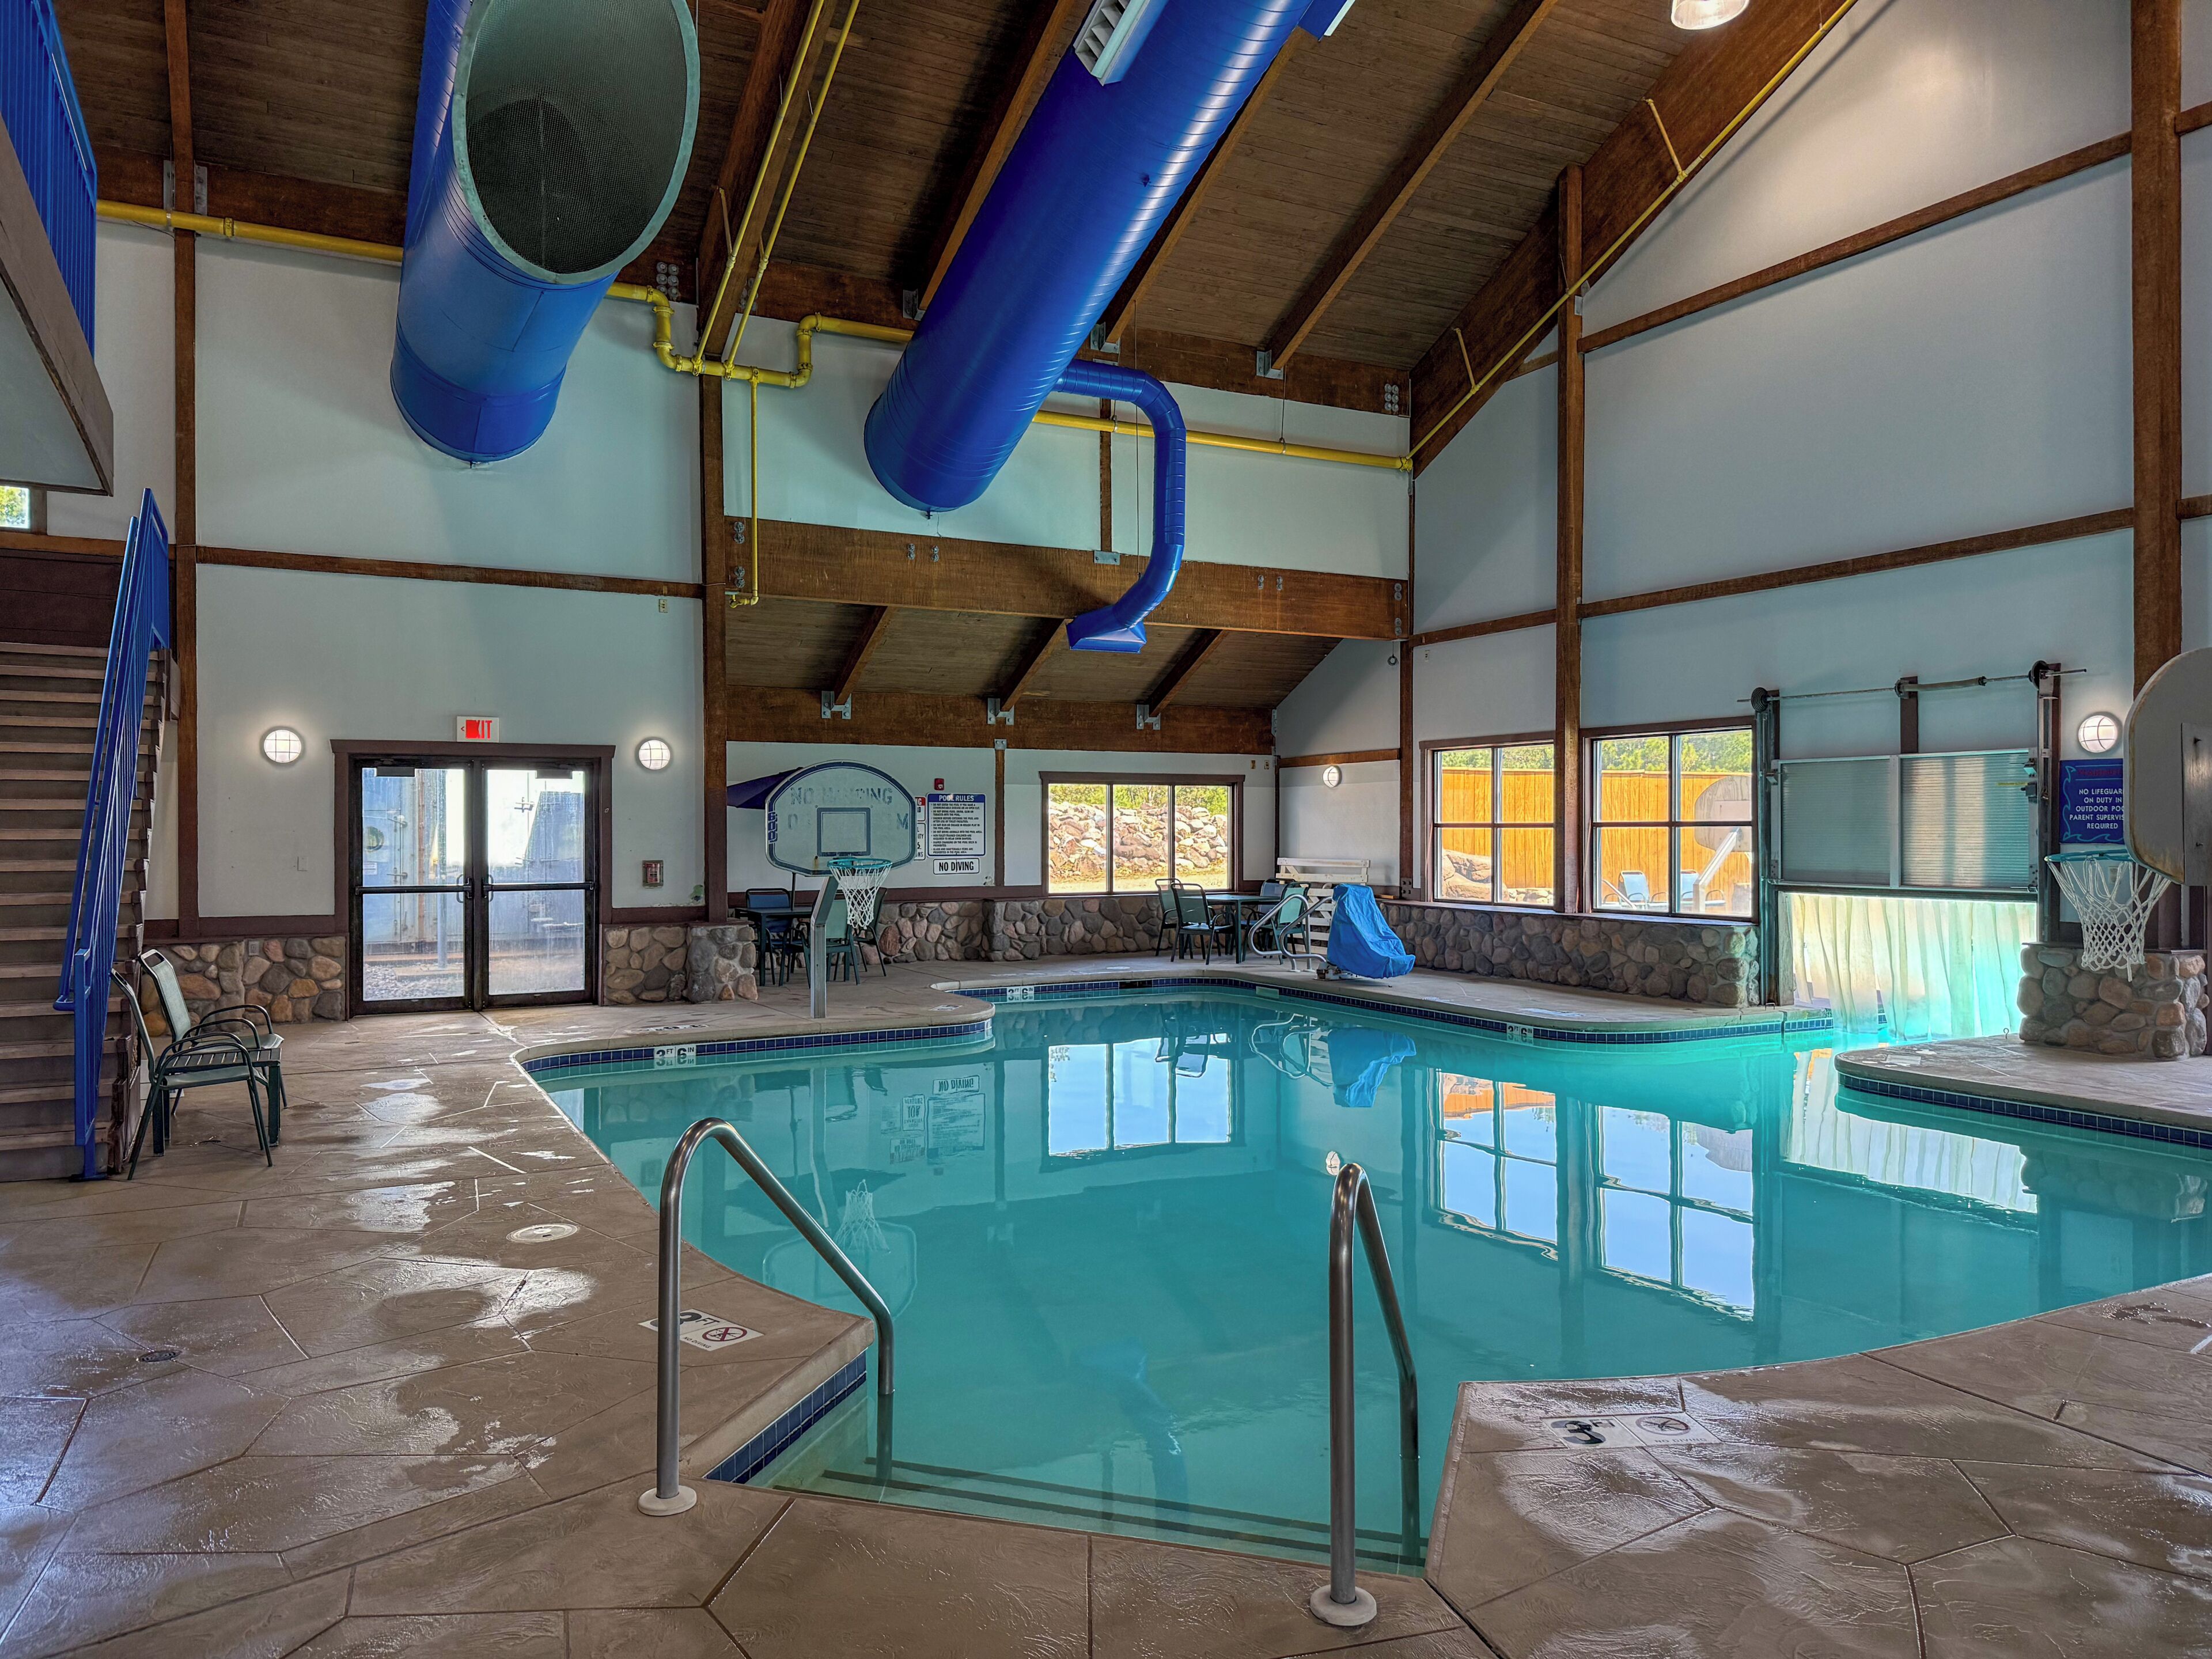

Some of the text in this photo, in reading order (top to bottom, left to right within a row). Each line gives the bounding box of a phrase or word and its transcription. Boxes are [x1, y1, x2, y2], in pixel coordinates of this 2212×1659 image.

[939, 861, 974, 871] NO DIVING
[677, 1048, 687, 1059] 6
[695, 1317, 720, 1325] FT
[692, 1340, 711, 1349] DIVING
[1551, 1419, 1616, 1445] 3 FT
